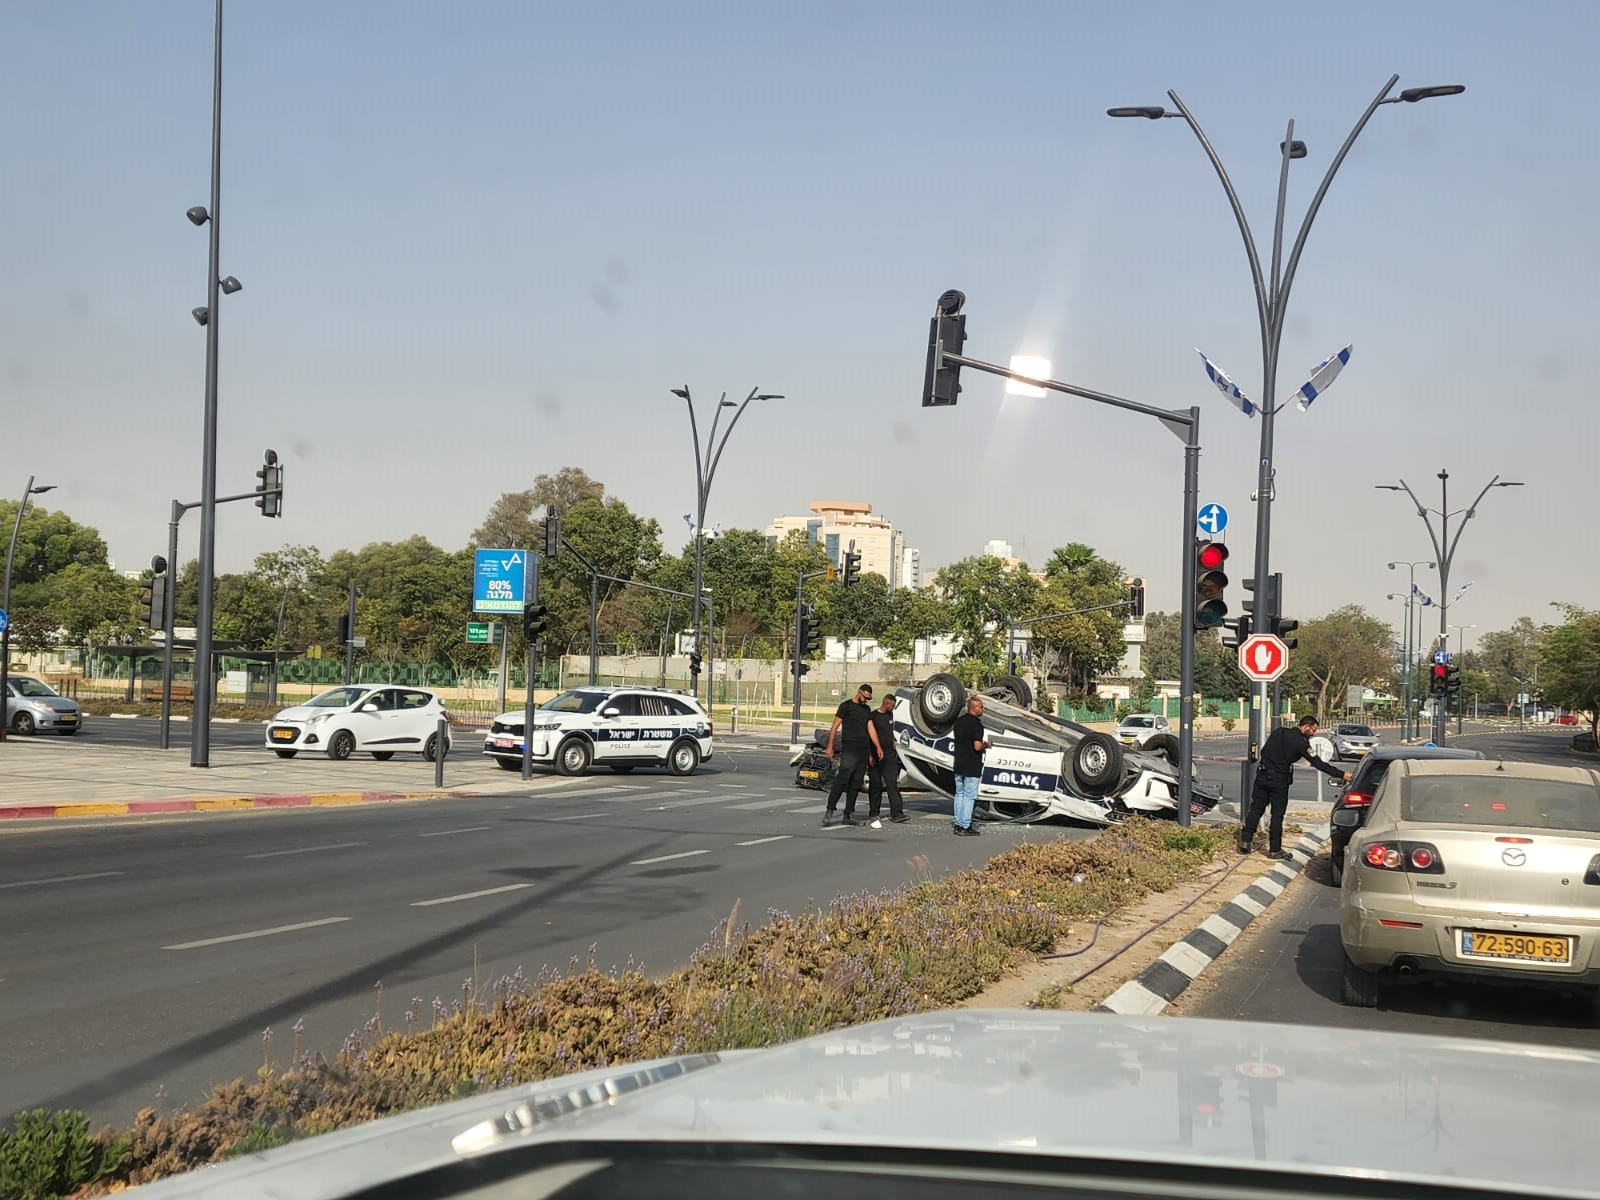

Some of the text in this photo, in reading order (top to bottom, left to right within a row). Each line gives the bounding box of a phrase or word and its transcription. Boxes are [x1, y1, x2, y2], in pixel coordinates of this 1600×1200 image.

[488, 580, 512, 591] 80%
[486, 590, 513, 599] מלגה
[609, 730, 673, 739] משטרת ישראל
[996, 758, 1031, 768] POLICE
[993, 772, 1040, 790] ישראל
